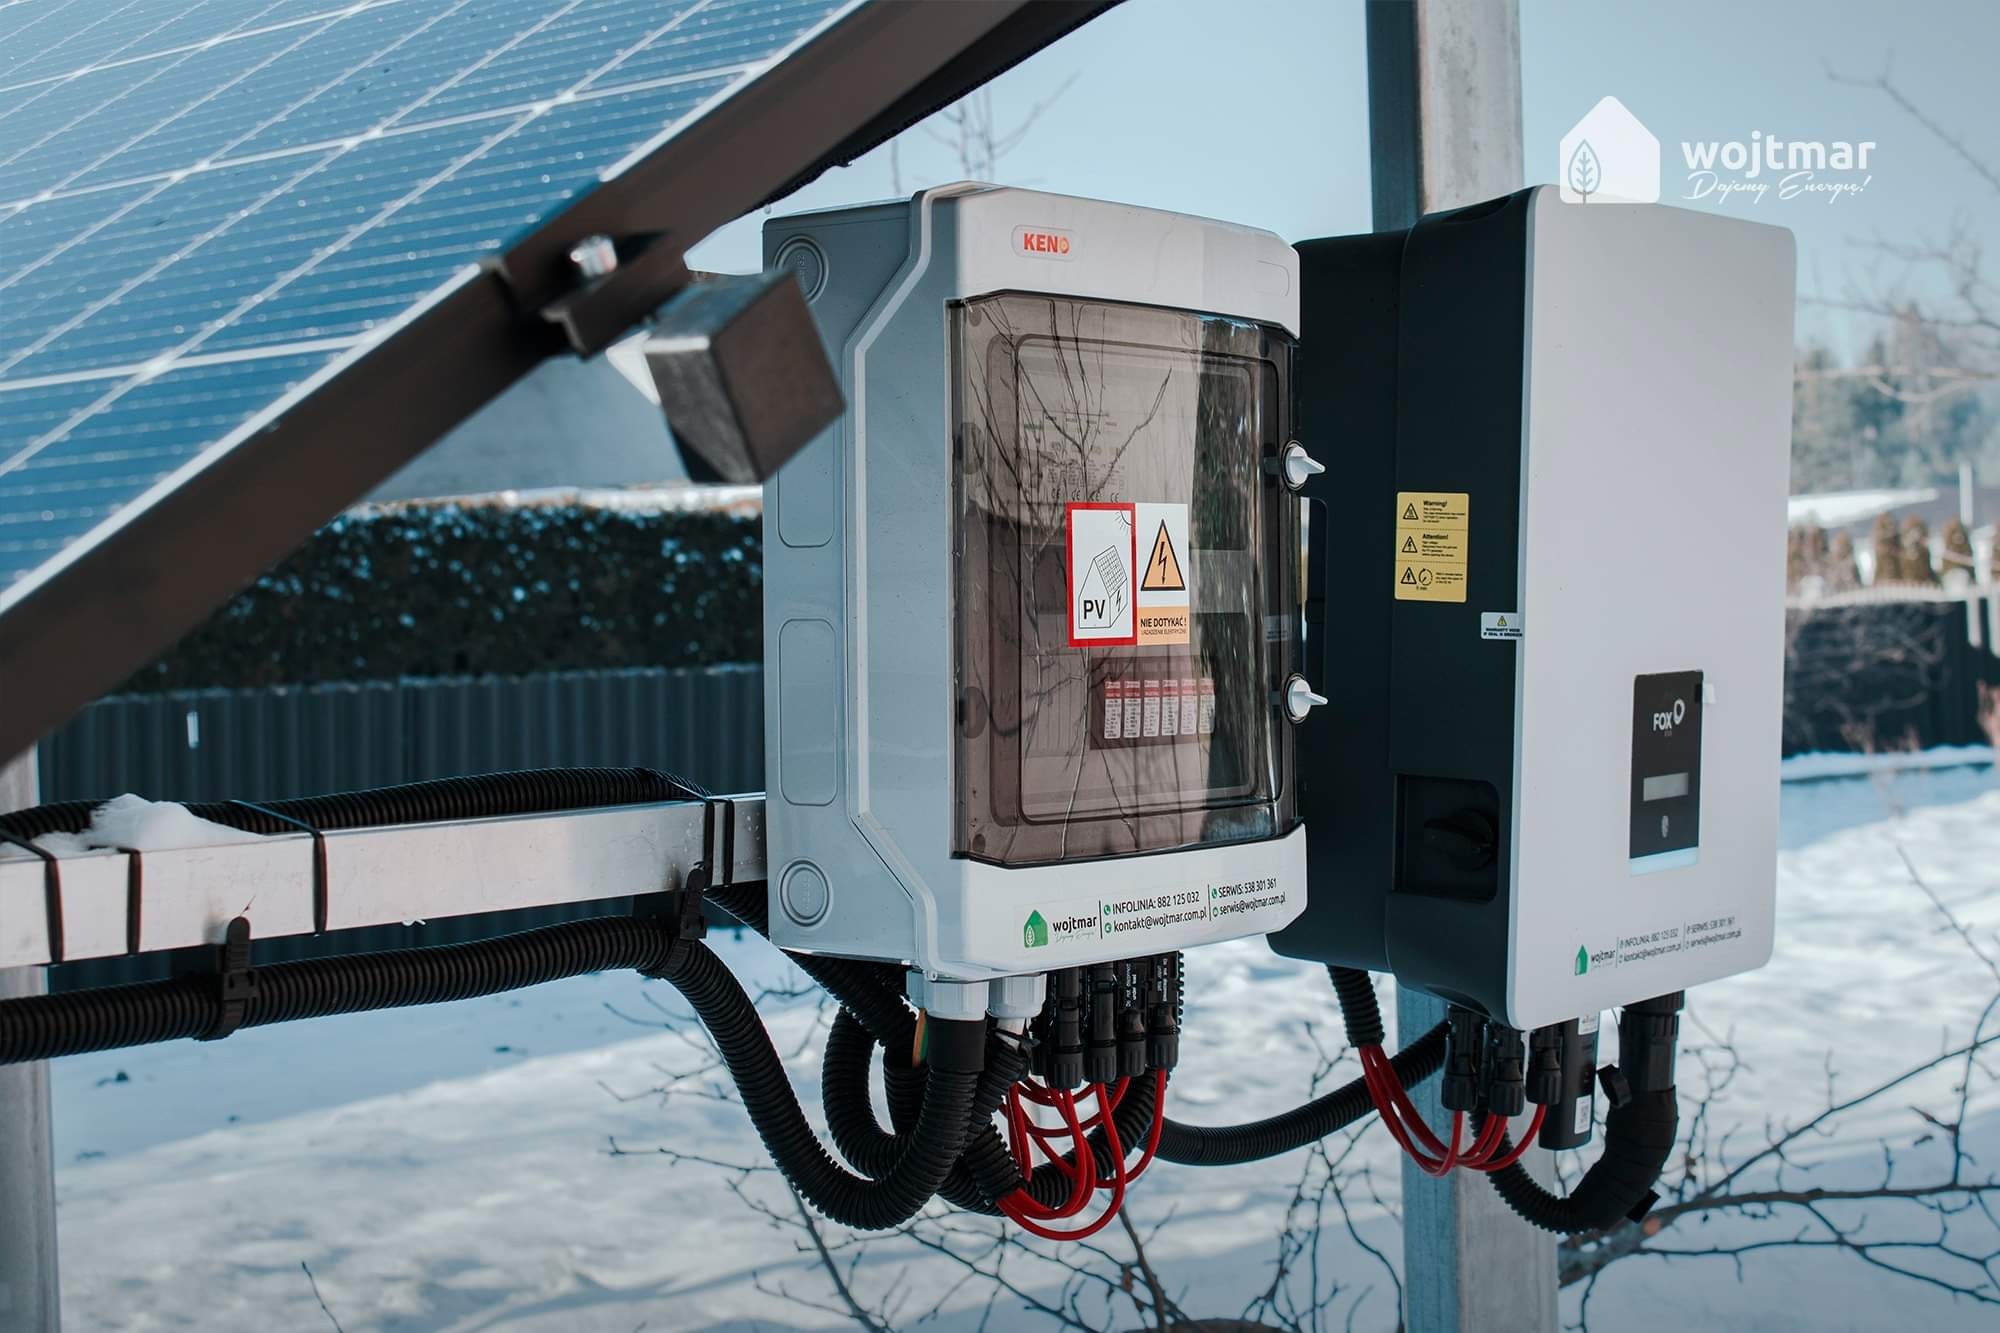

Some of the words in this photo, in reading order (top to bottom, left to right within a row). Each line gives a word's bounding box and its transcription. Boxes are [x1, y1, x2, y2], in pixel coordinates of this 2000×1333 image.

[1083, 599, 1105, 620] PV
[1140, 617, 1152, 628] NIE
[1653, 711, 1673, 731] FOX
[1219, 883, 1244, 898] SERWIS:
[1112, 898, 1156, 915] INFOLINIA:
[1157, 896, 1171, 908] 882
[1172, 893, 1185, 906] 125
[1187, 891, 1200, 904] 032
[1220, 891, 1286, 916] serwis@wojtmar.com.pl
[1053, 916, 1097, 934] wojtmar
[1114, 906, 1208, 932] kontakt@wojtmar.com.pl
